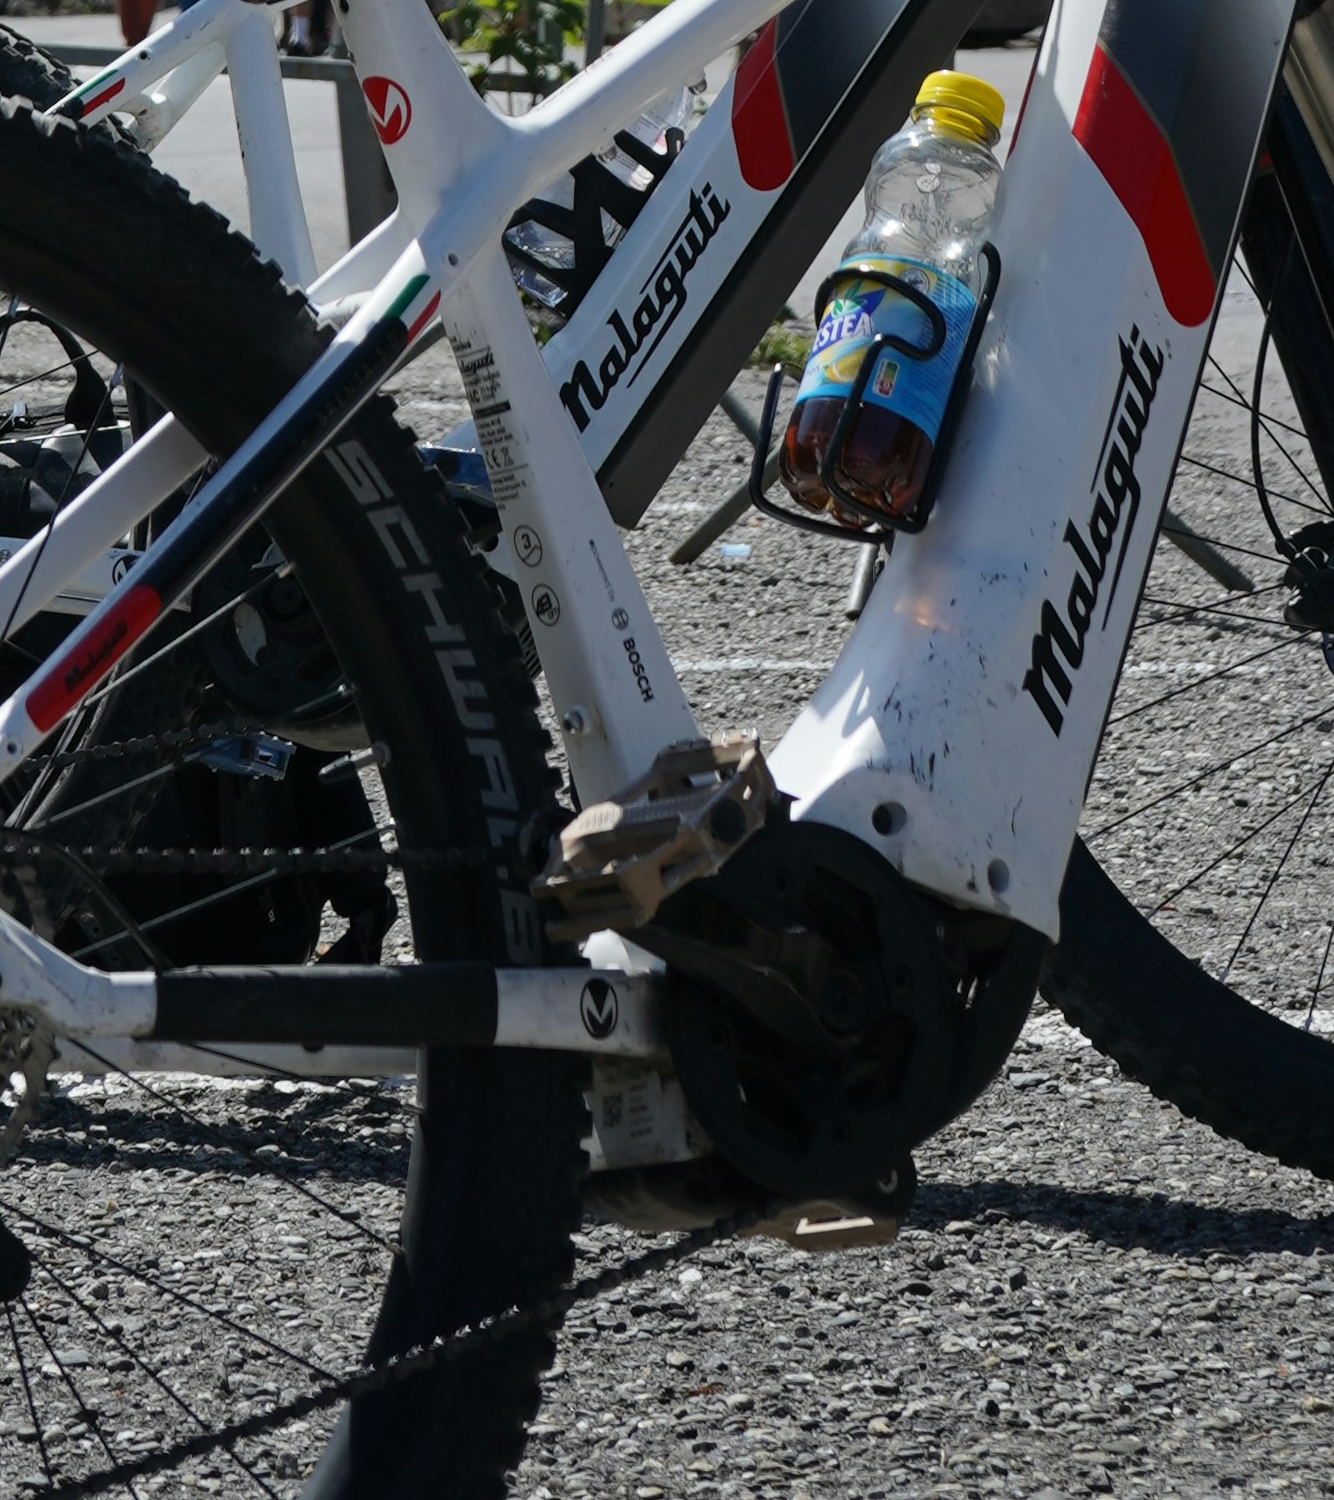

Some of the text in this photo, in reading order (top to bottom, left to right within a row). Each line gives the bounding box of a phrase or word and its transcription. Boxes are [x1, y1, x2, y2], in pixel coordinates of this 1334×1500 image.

[560, 180, 732, 436] Malaguti
[624, 637, 655, 704] BOSCH
[1022, 322, 1172, 740] Malaguti
[327, 439, 540, 965] SCHWALB
